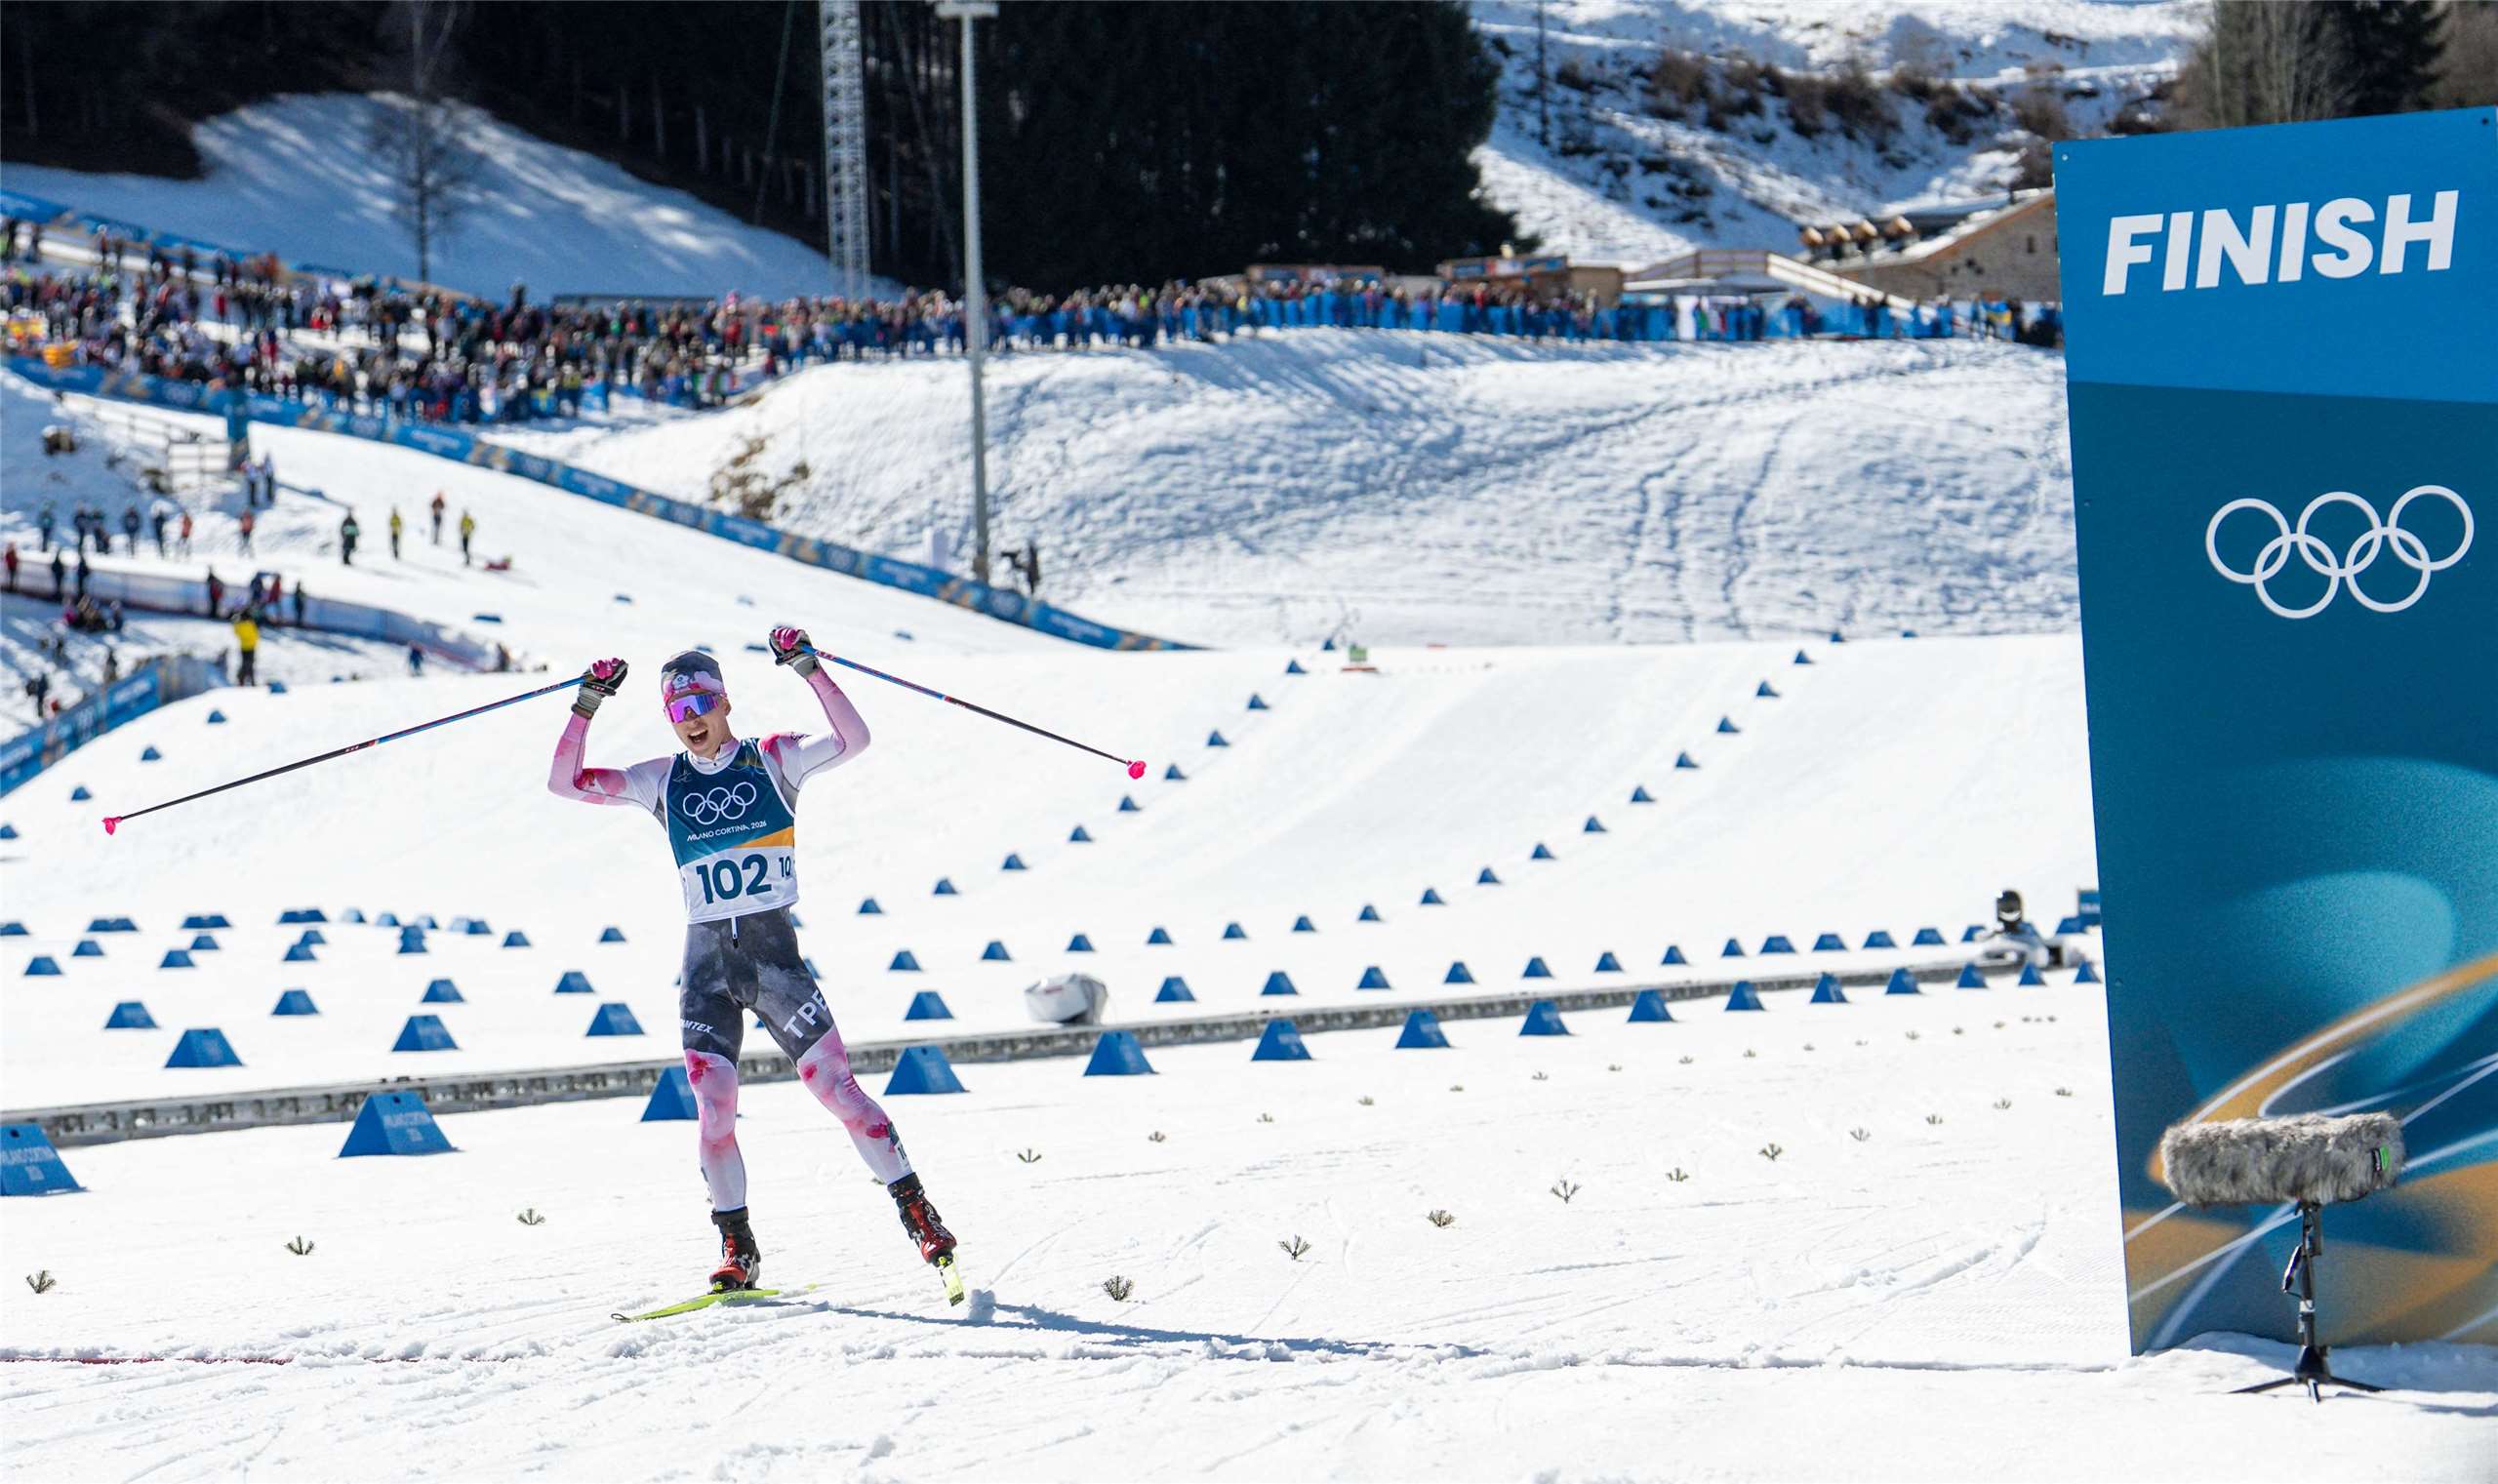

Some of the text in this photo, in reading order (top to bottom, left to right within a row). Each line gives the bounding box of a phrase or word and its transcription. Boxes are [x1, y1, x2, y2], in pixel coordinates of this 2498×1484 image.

[2103, 190, 2459, 296] FINISH
[687, 820, 768, 842] MILANO CORTINA 2026
[696, 854, 772, 904] 102
[779, 856, 795, 878] 10
